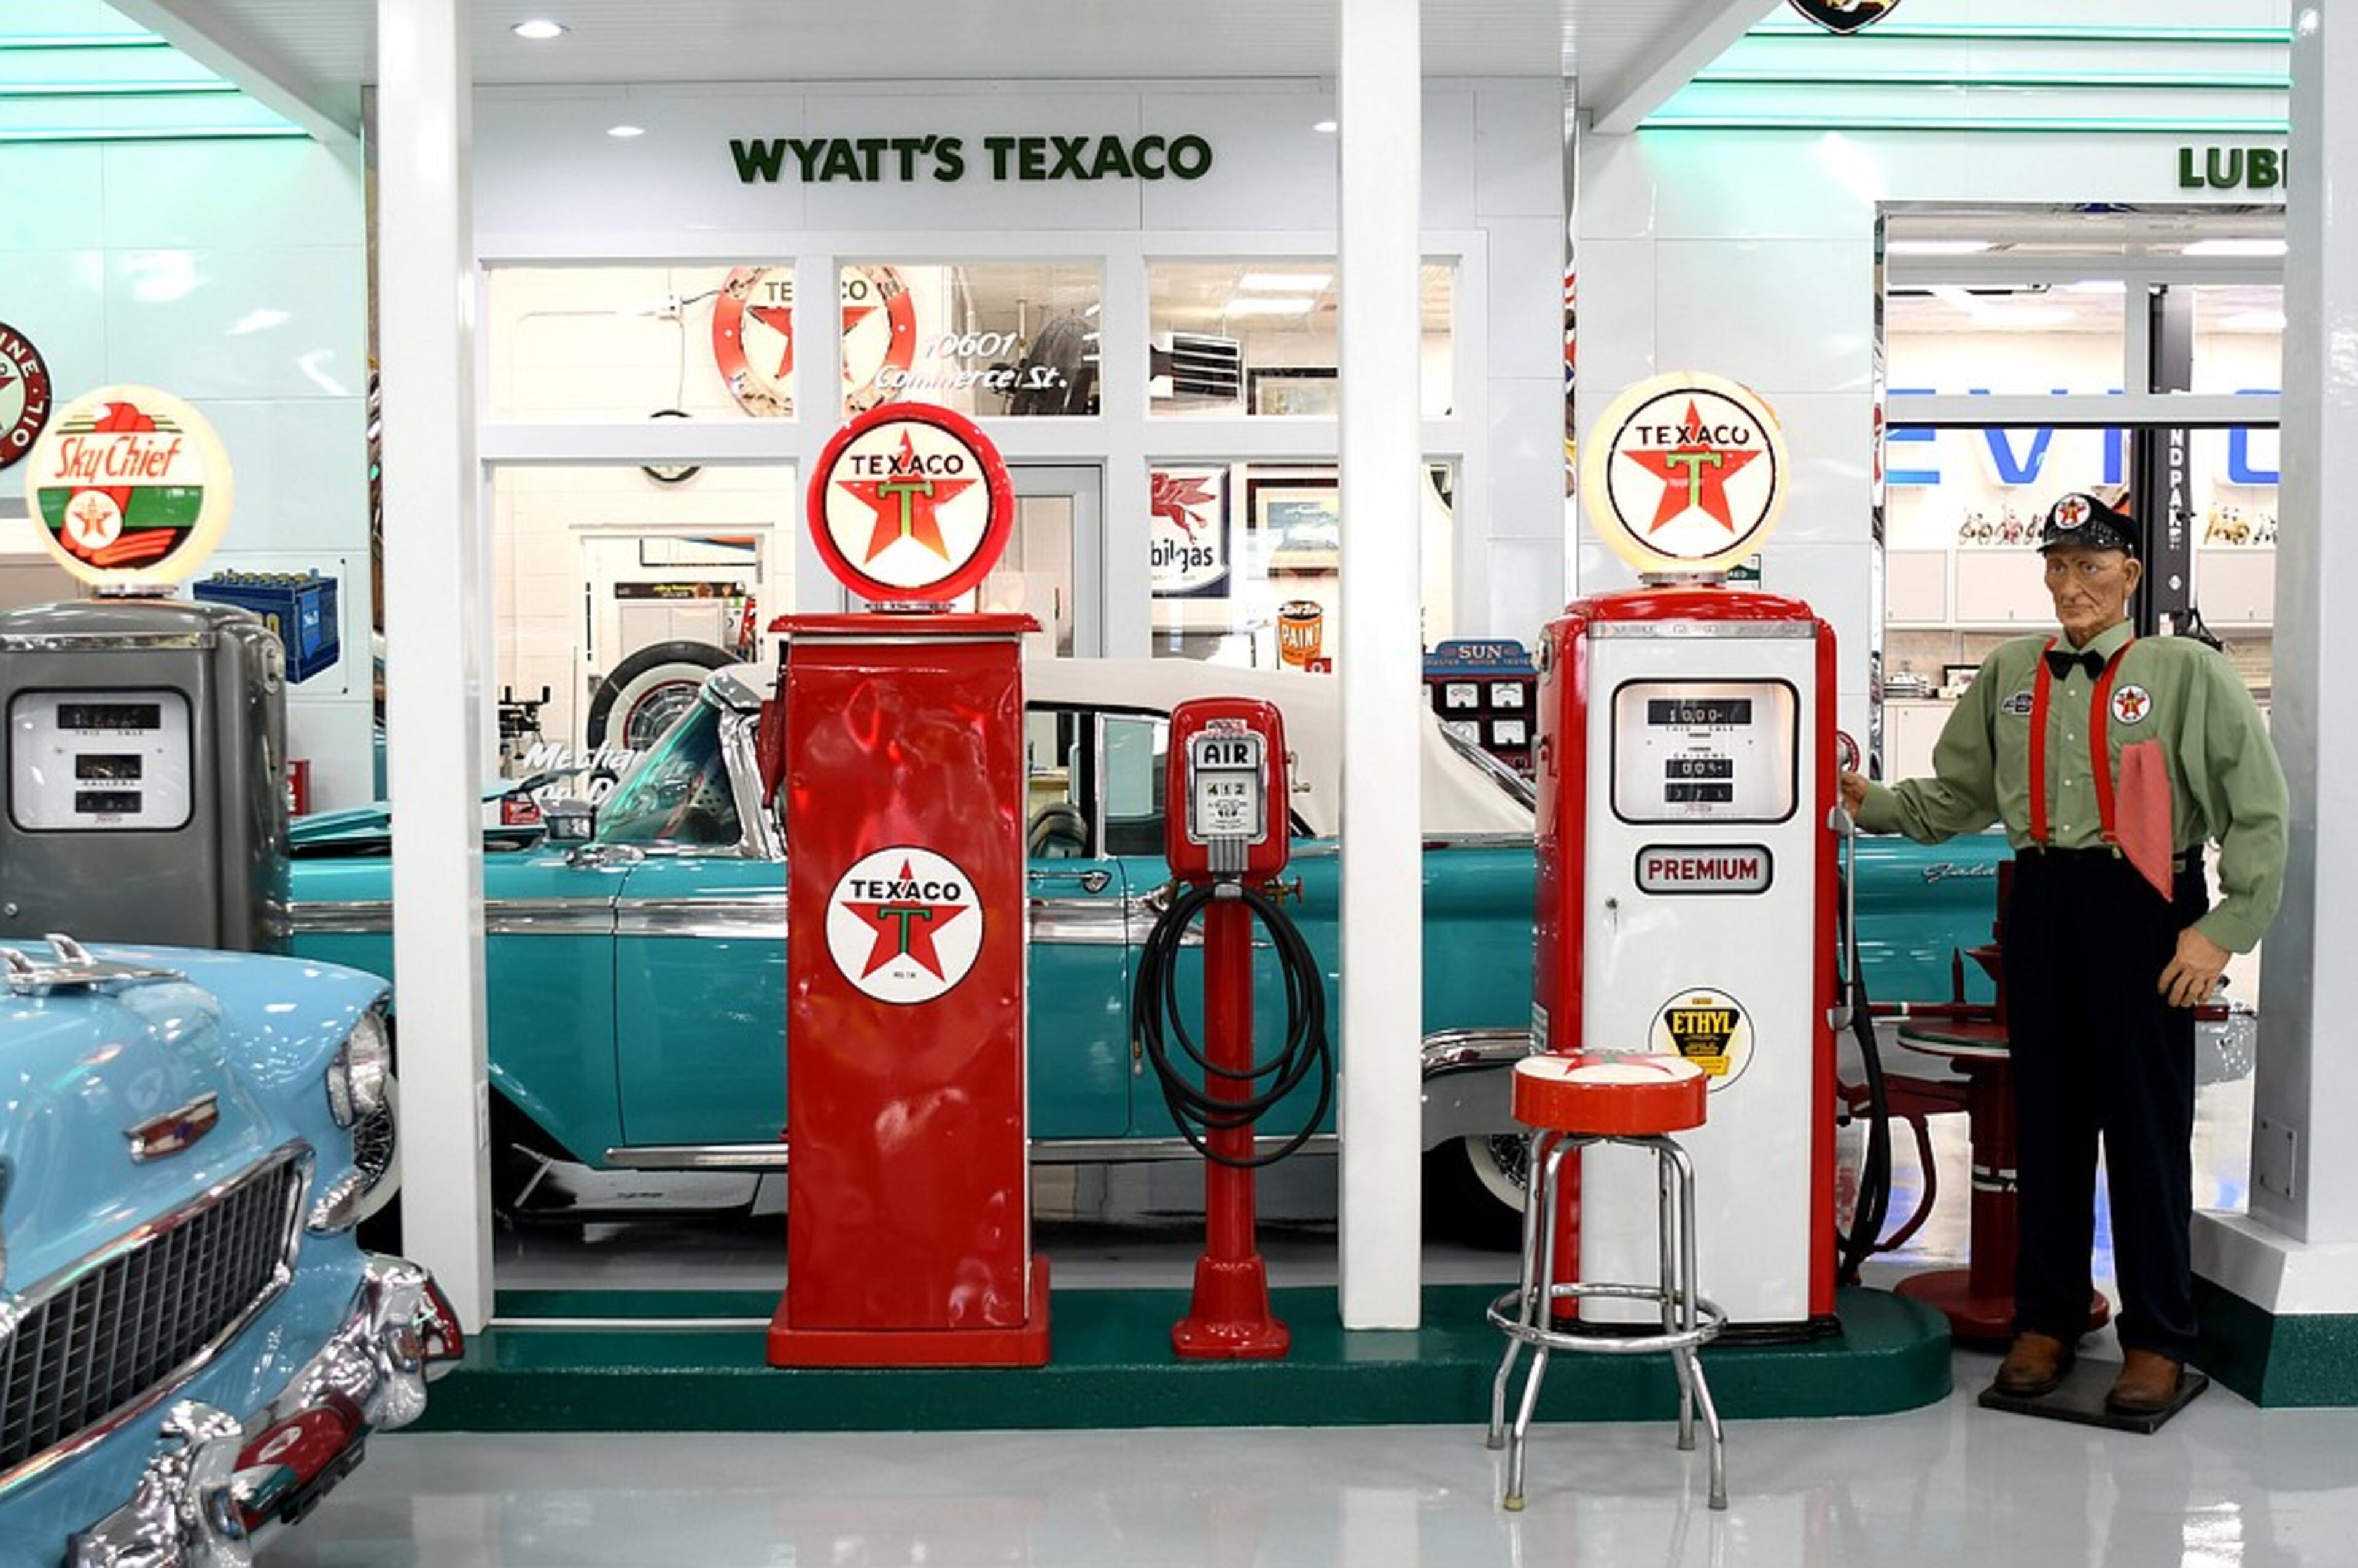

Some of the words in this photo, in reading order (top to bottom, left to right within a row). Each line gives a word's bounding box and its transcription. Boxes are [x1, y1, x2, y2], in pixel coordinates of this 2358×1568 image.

[729, 136, 965, 184] WYATT'S
[983, 134, 1213, 181] TEXACO
[2178, 147, 2289, 188] LUB
[12, 400, 44, 447] OIL
[1636, 425, 1750, 446] TEXACO
[54, 436, 104, 484] Sky
[104, 435, 182, 478] Chief
[850, 454, 964, 475] TEXACO
[1458, 645, 1502, 659] SUN
[1204, 743, 1248, 764] AIR
[1648, 858, 1758, 881] PREMIUM
[849, 879, 962, 901] TEXACO
[1672, 1011, 1733, 1034] ETHYL
